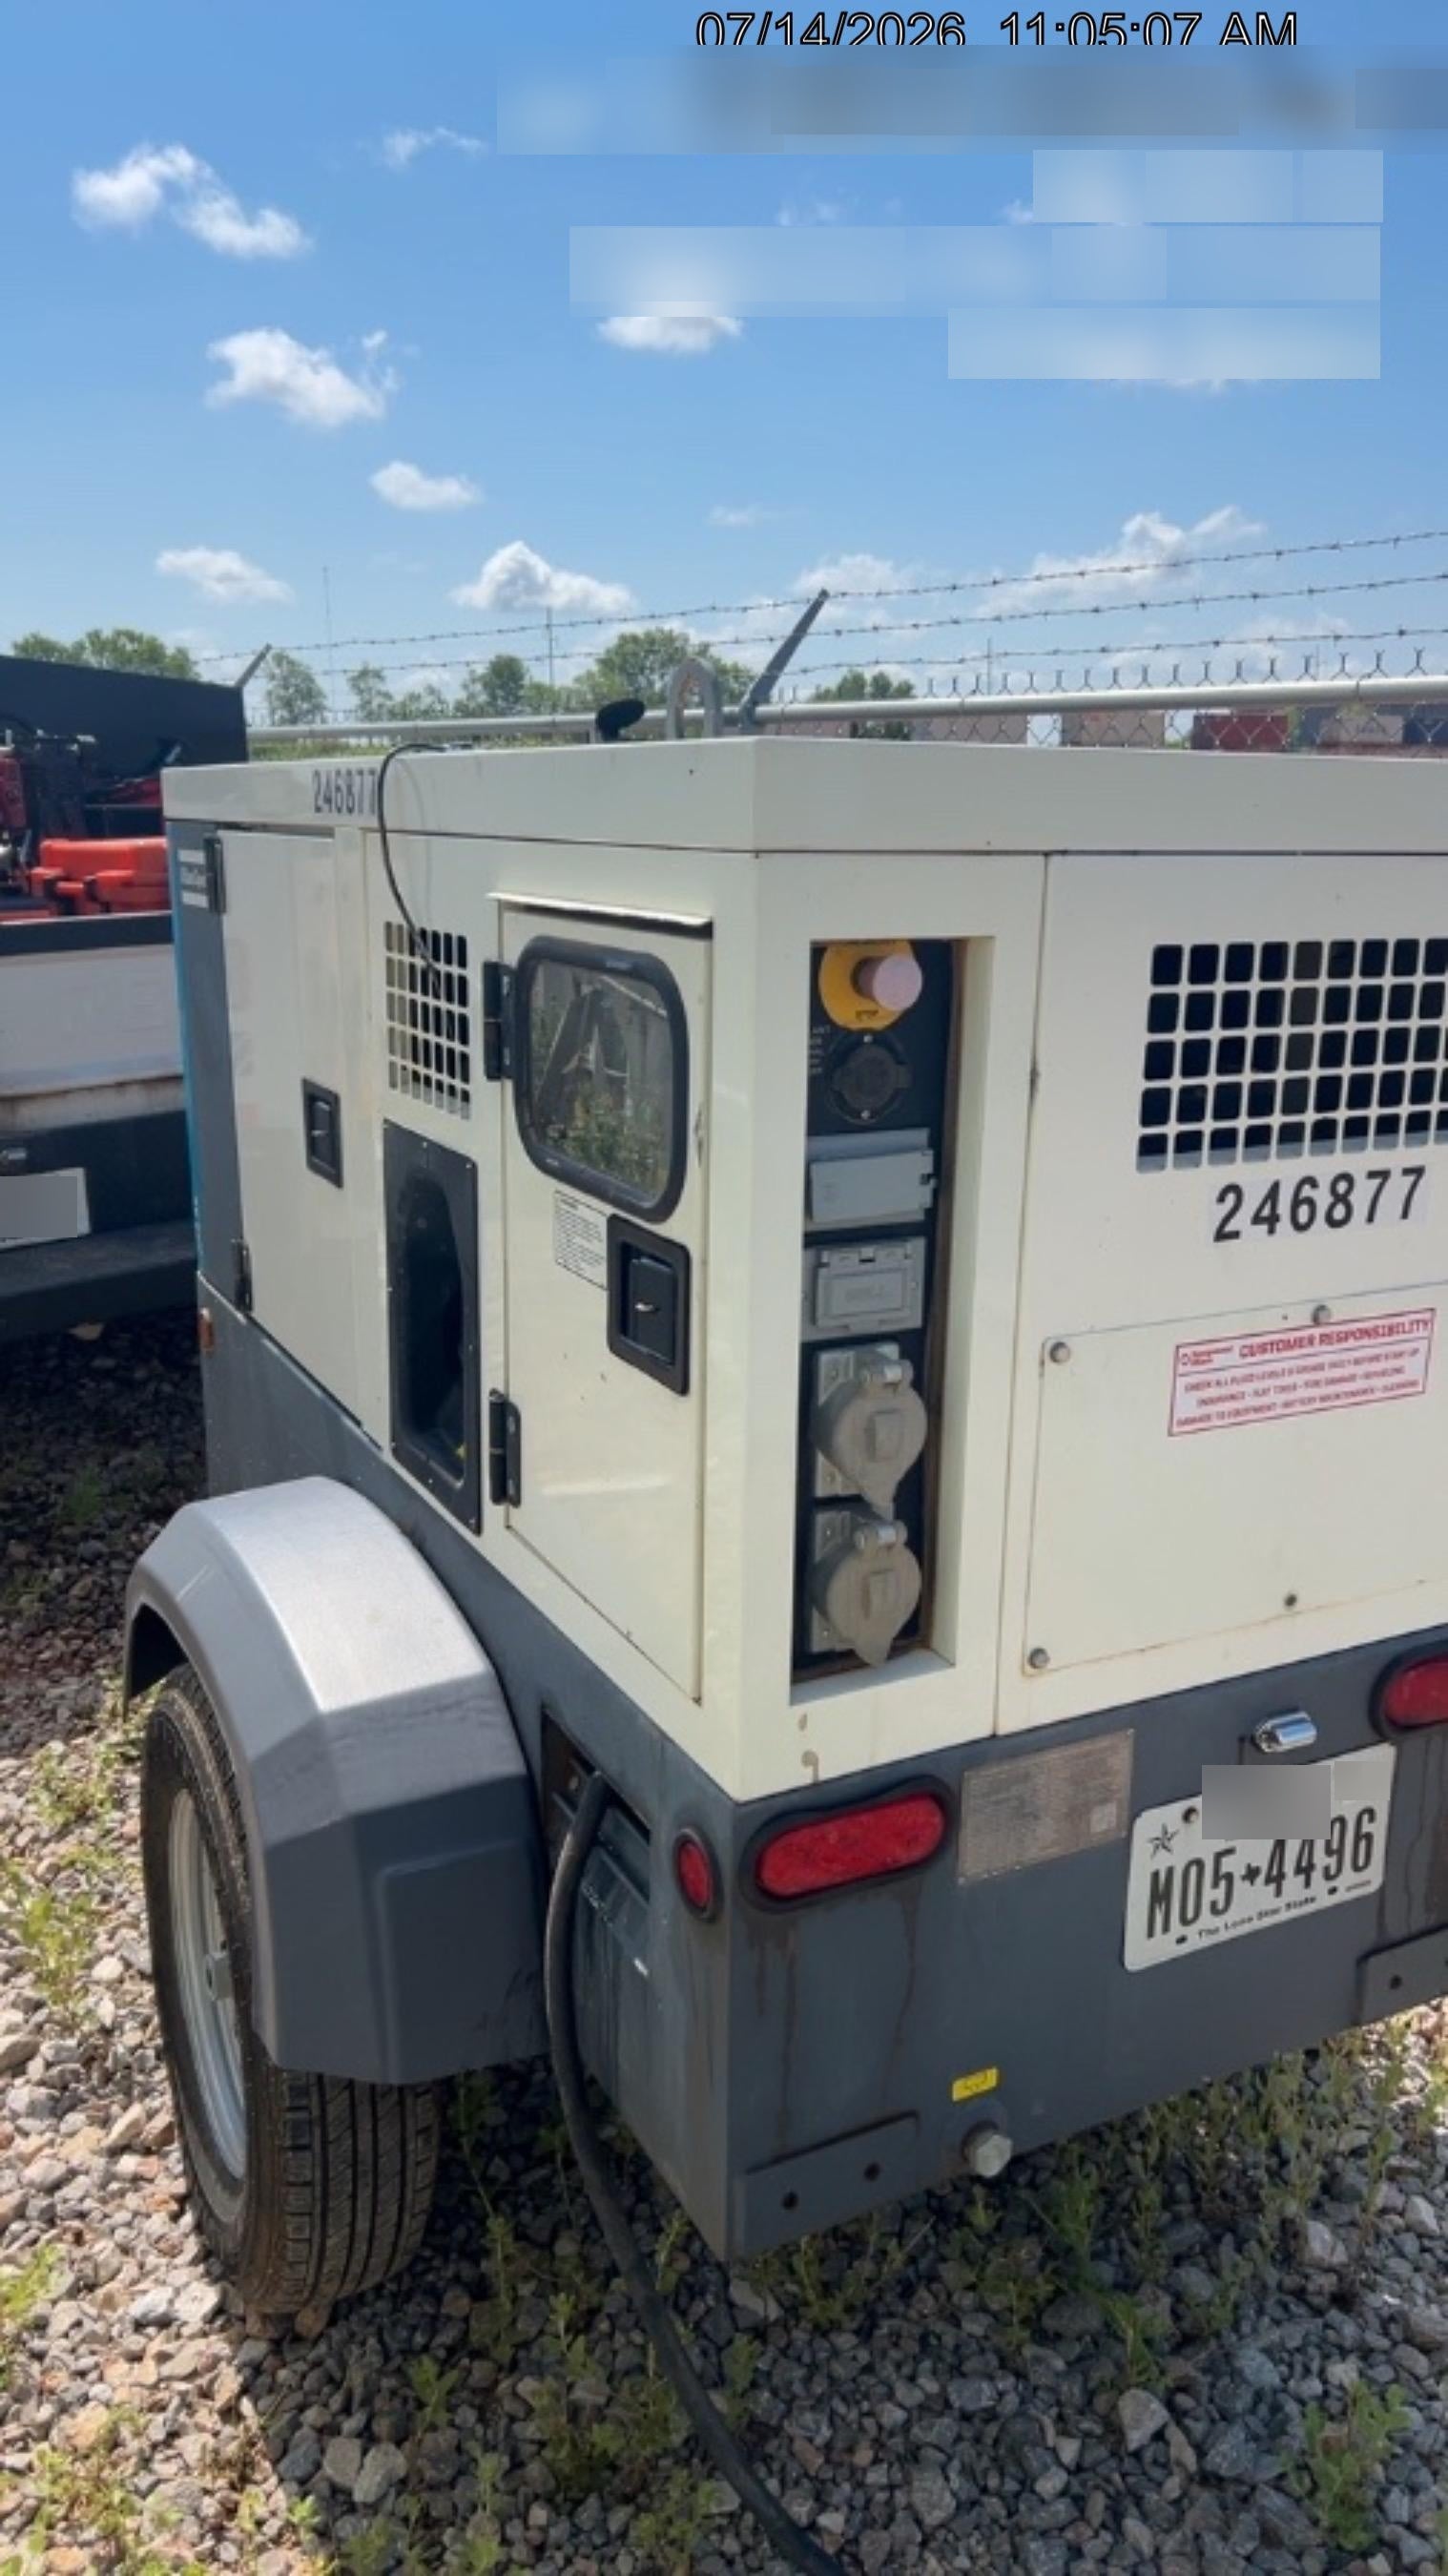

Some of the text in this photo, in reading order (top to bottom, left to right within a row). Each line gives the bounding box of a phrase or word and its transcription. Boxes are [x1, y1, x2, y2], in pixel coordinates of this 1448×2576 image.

[312, 767, 378, 815] 246877
[1213, 1165, 1426, 1242] 246877
[1239, 1334, 1316, 1359] CUSTOMER
[1319, 1319, 1430, 1346] RESPONSIBILITY
